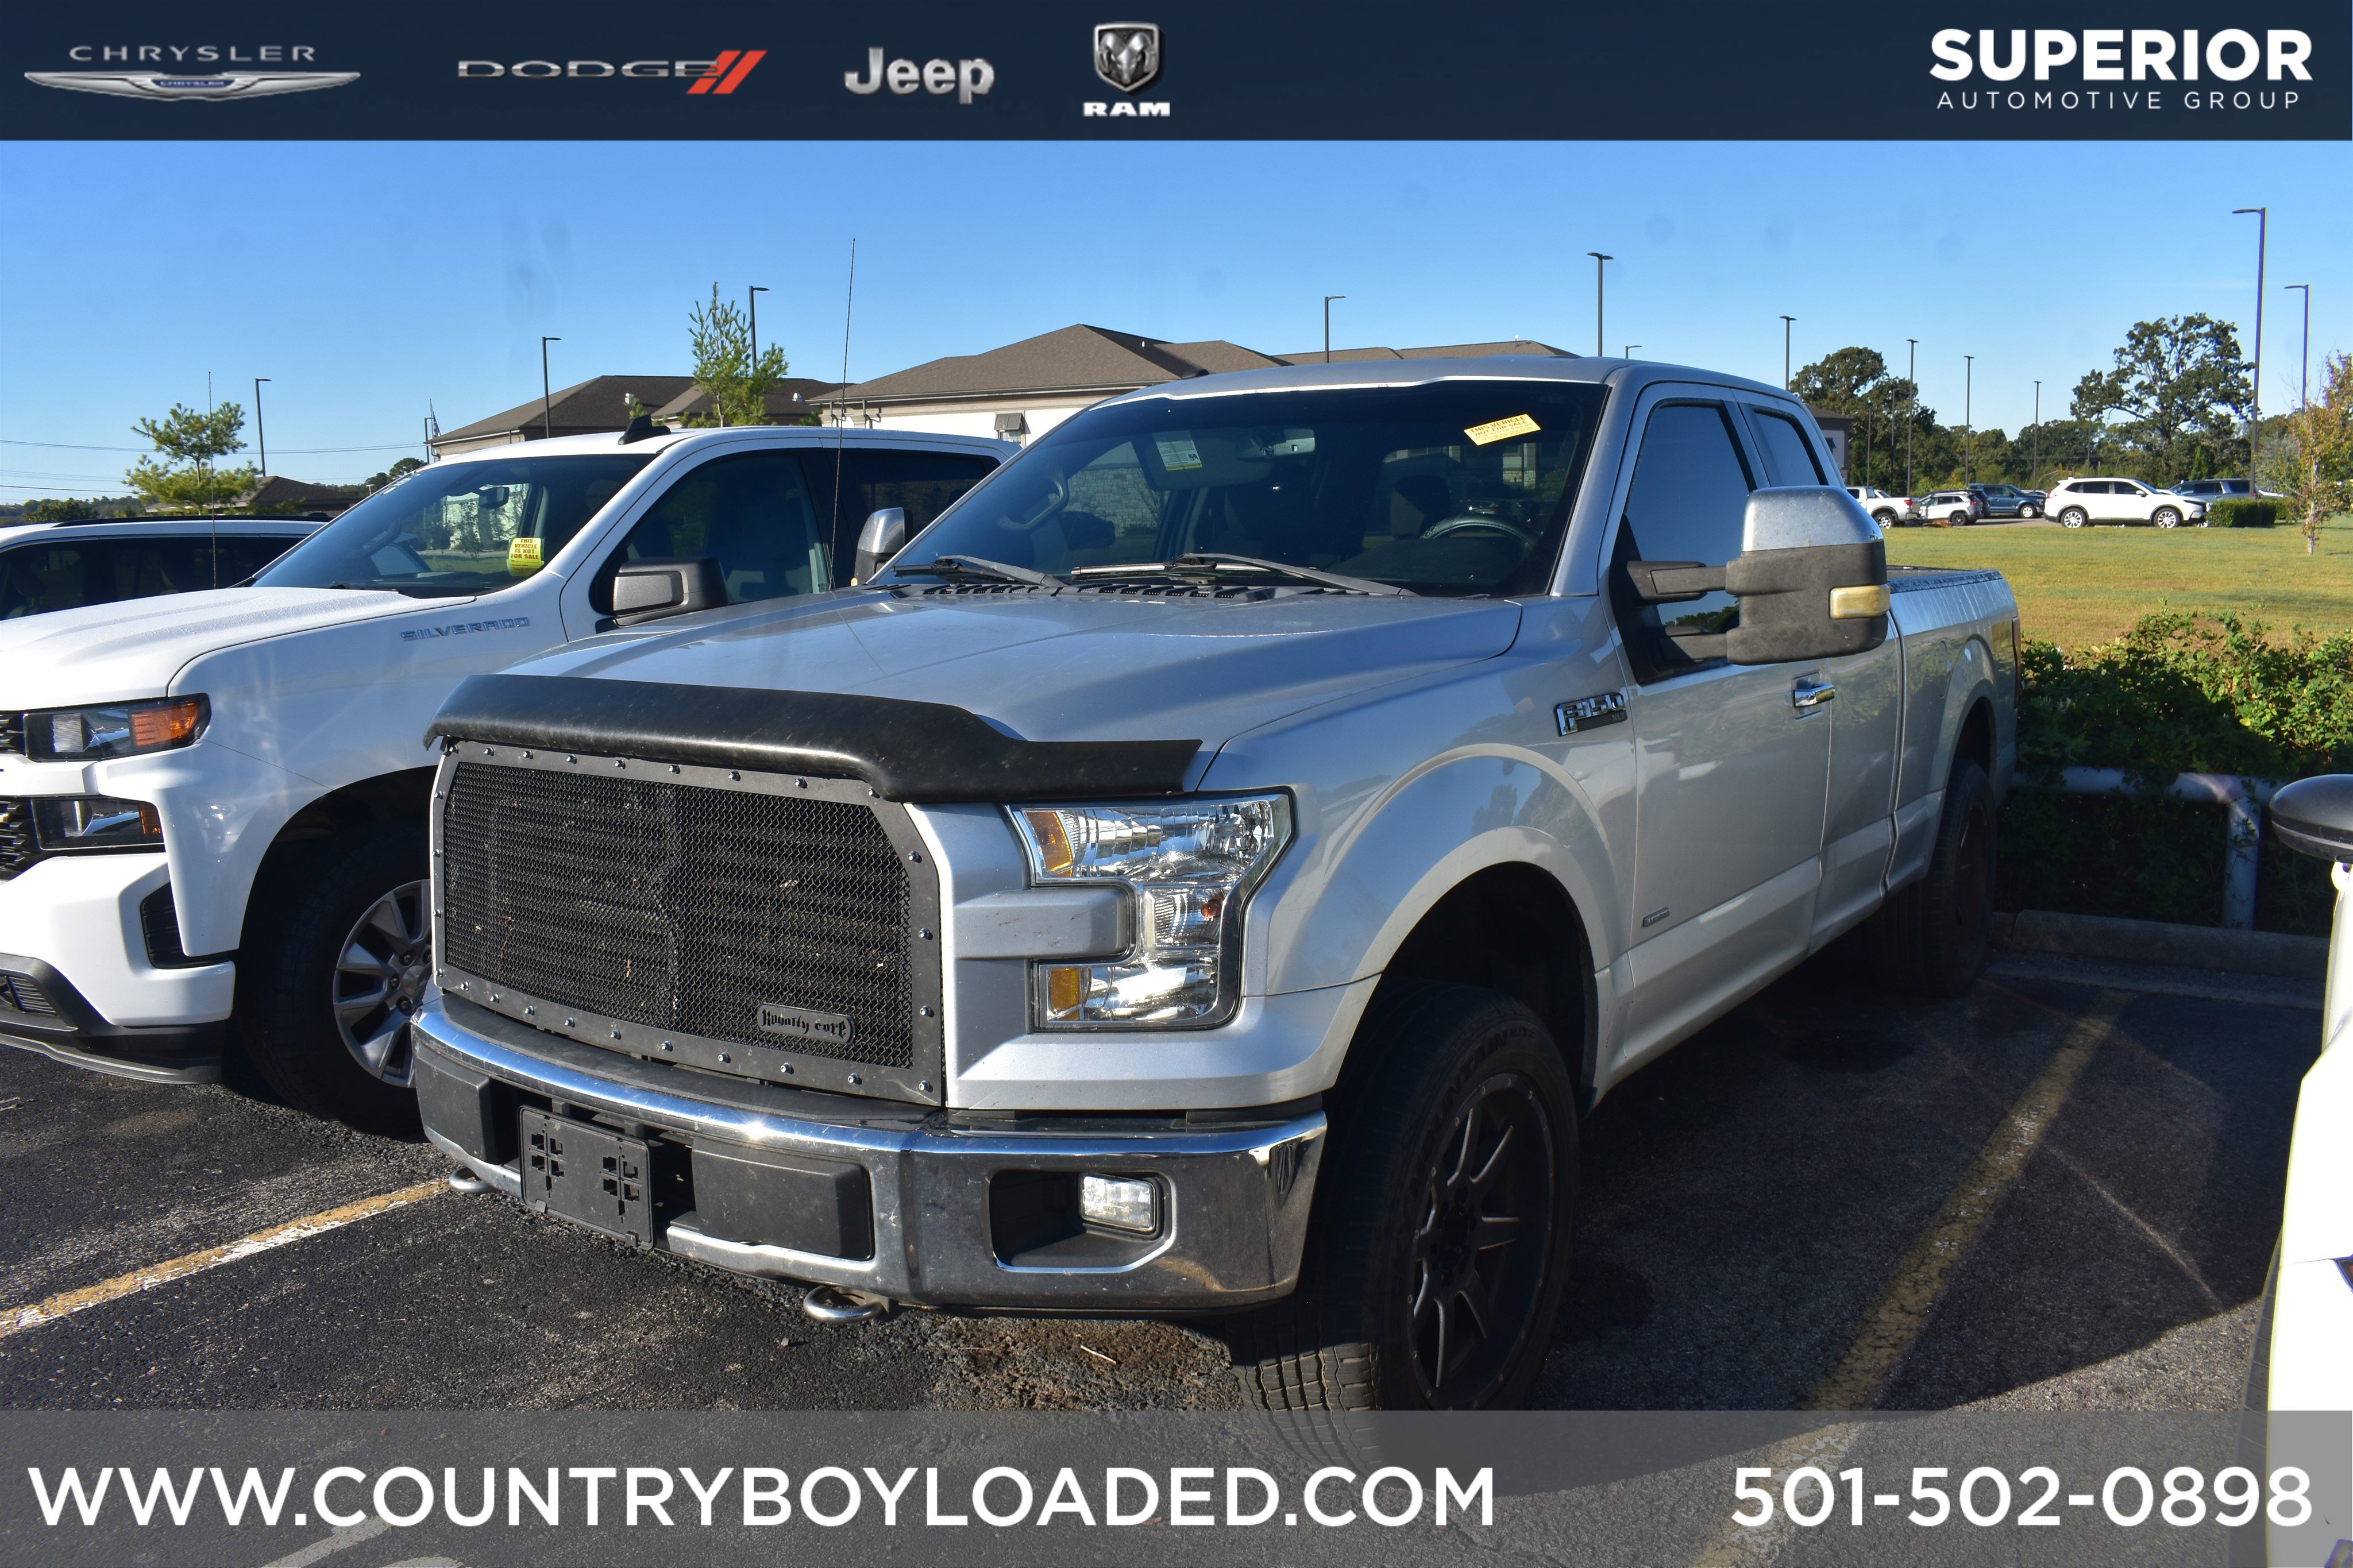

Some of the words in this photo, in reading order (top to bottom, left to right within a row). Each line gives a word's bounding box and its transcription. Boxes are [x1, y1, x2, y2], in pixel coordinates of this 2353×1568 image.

[1470, 424, 1490, 433] THIS
[1490, 415, 1526, 427] VEHICLE
[400, 617, 530, 642] SILVERADO
[1408, 1029, 1509, 1201] MOUNTAIN
